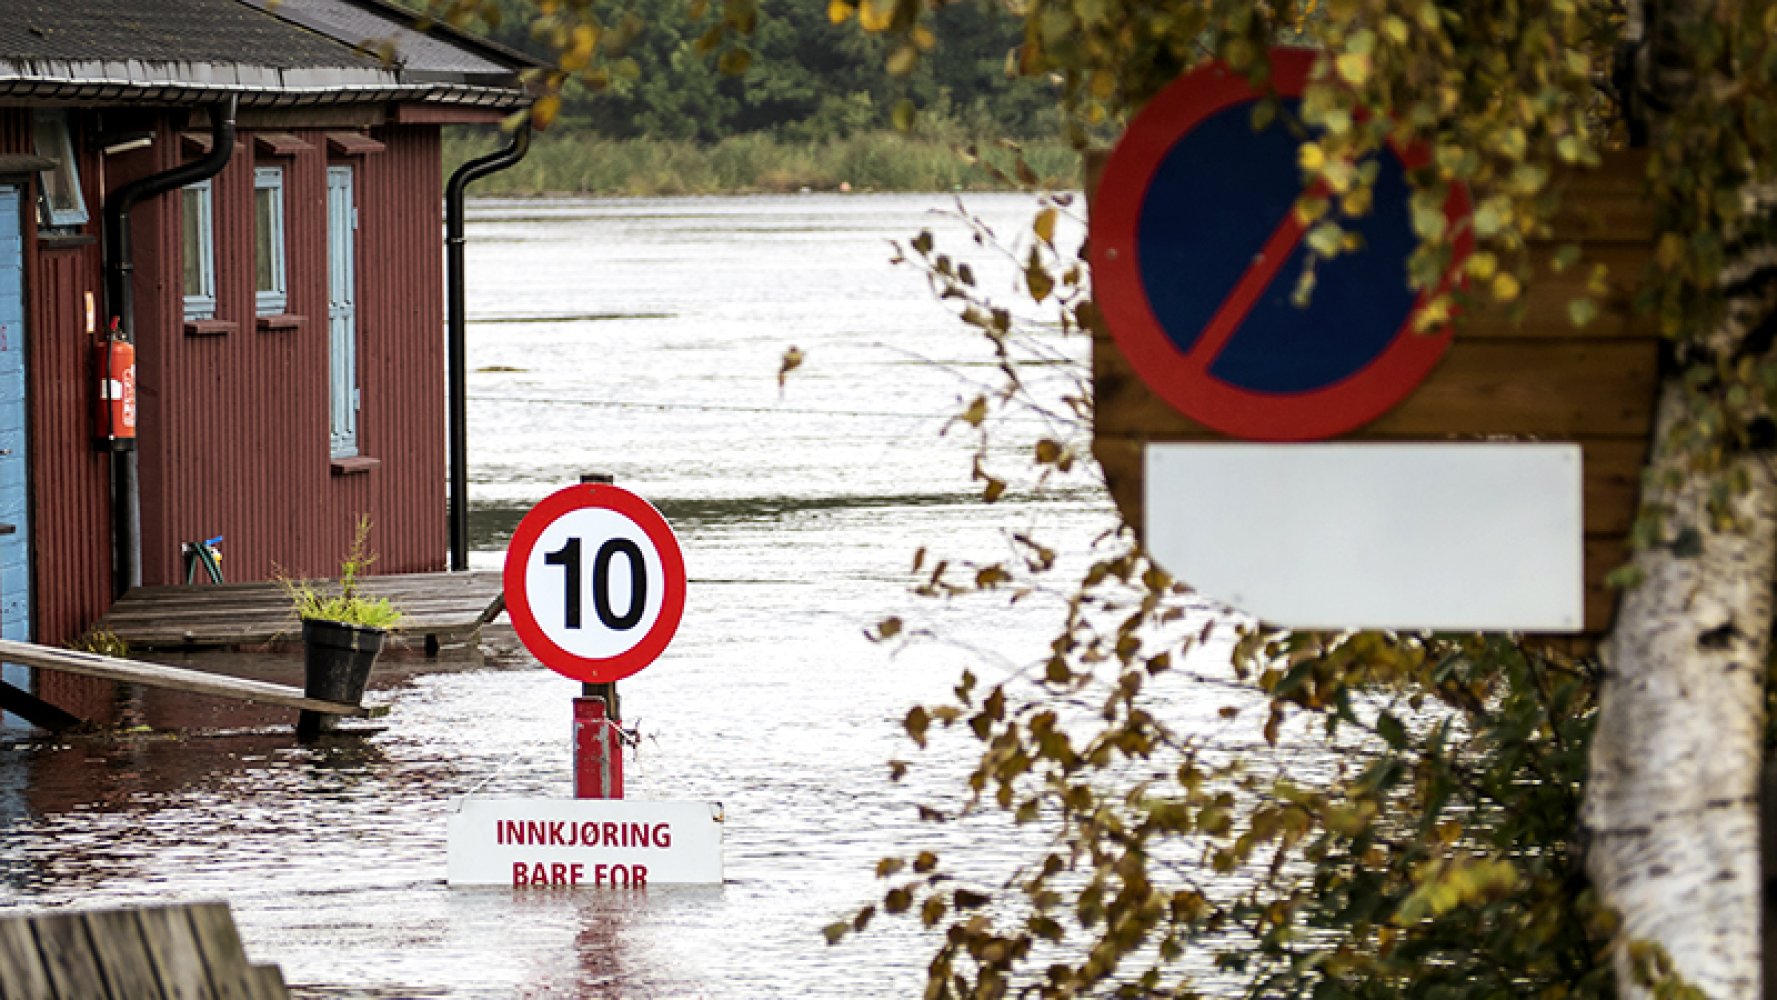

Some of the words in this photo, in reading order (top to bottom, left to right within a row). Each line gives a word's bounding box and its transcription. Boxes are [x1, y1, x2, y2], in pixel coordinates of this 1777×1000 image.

[544, 537, 648, 632] 10
[496, 819, 672, 848] INNKJØRING
[594, 864, 648, 888] FOR
